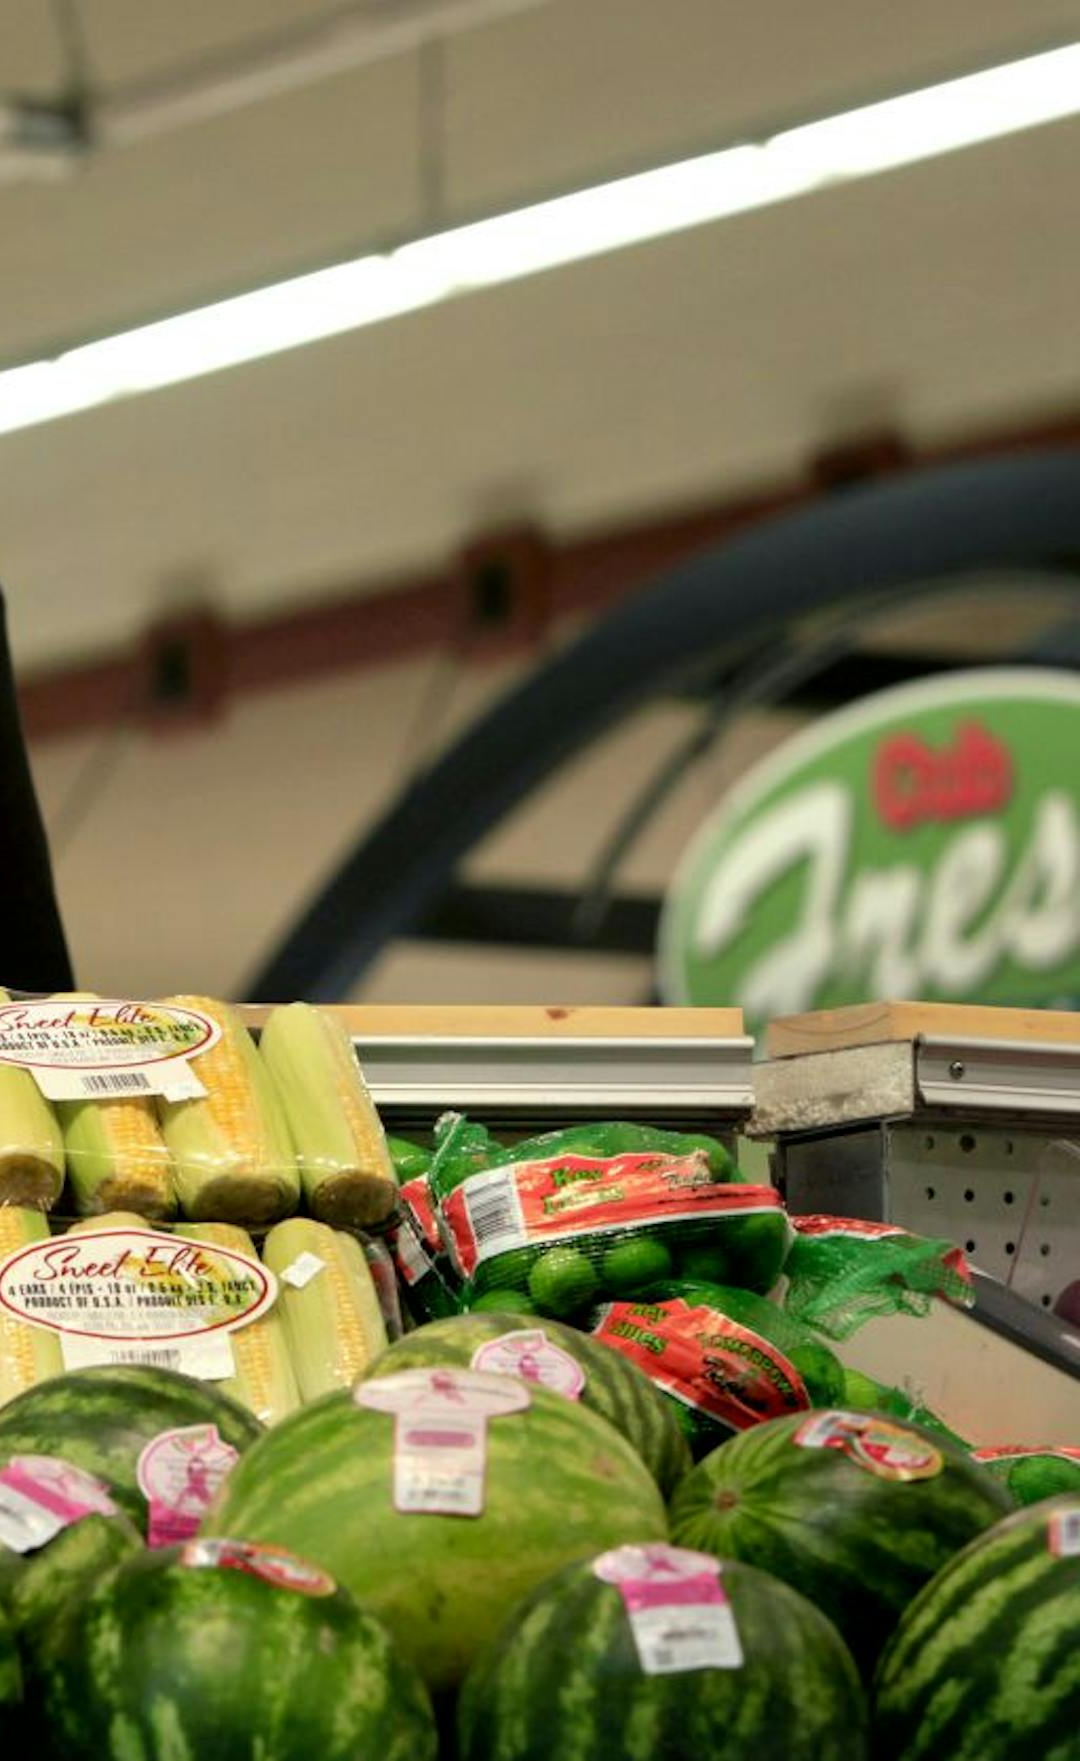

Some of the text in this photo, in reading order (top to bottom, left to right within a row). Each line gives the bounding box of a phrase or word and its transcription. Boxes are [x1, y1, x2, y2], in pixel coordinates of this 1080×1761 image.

[873, 715, 1013, 835] Cub
[33, 1245, 214, 1281] Sweet Elite
[24, 1296, 72, 1309] PRODUCT
